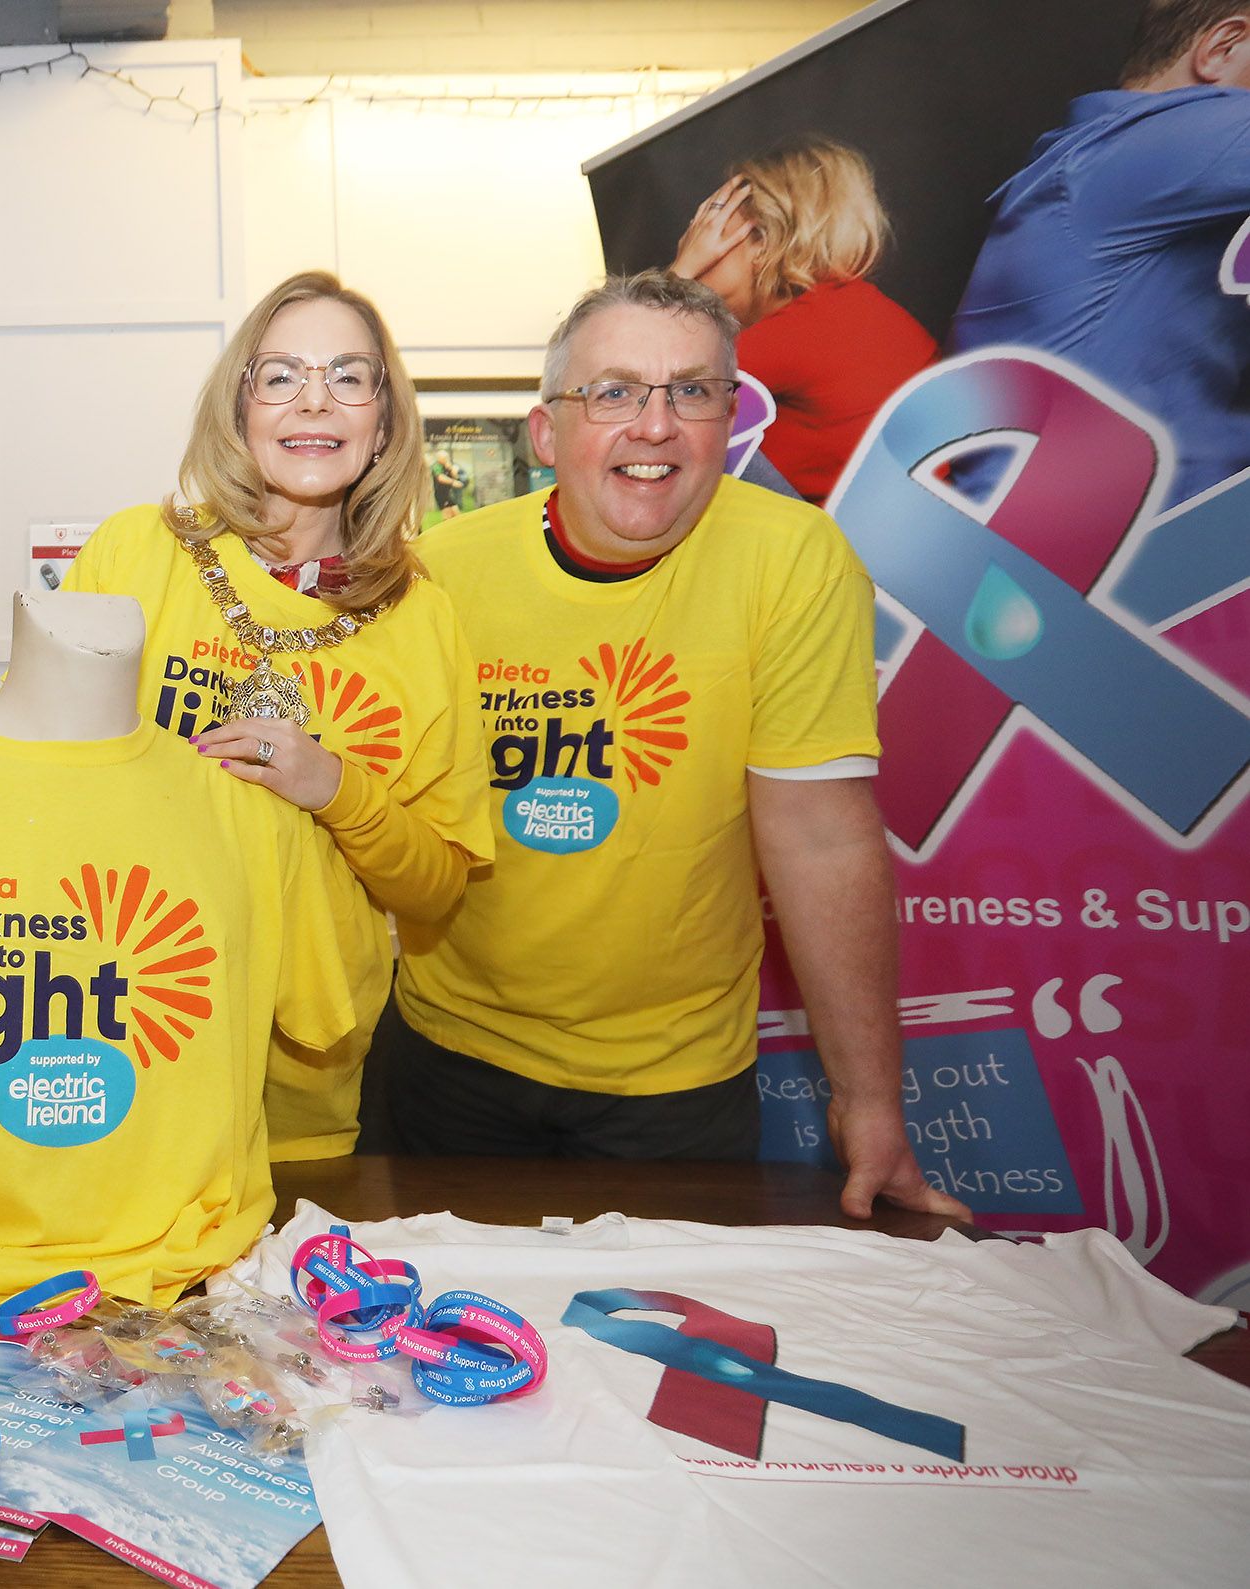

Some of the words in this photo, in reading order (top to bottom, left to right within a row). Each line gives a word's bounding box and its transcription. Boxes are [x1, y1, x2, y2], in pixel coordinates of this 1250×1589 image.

[62, 548, 79, 557] Plea
[478, 658, 550, 684] pieta
[480, 688, 597, 713] arkness
[494, 715, 539, 731] into
[490, 717, 614, 791] ght
[576, 788, 590, 799] by
[516, 799, 594, 822] electric
[523, 816, 594, 840] Ireland
[896, 894, 1063, 927] reness
[1080, 888, 1120, 930] &
[29, 1054, 84, 1068] supported
[87, 1053, 101, 1067] by
[933, 1053, 1010, 1089] out
[9, 1073, 106, 1100] electric
[26, 1097, 106, 1127] Ireland
[794, 1121, 821, 1148] is
[905, 1101, 992, 1153] ngth
[926, 1158, 1064, 1195] akness
[18, 1318, 44, 1330] Reach
[45, 1313, 63, 1326] Out
[442, 1306, 469, 1319] Support
[470, 1311, 476, 1321] &
[477, 1313, 520, 1342] Awareness
[336, 1346, 375, 1360] Awareness
[376, 1348, 383, 1358] &
[402, 1337, 445, 1360] Awareness
[445, 1351, 452, 1362] &
[453, 1353, 480, 1370] Support
[520, 1338, 541, 1364] Suicide
[479, 1378, 507, 1389] Group
[508, 1366, 532, 1382] Support
[14, 1389, 85, 1415] Suicide
[426, 1385, 453, 1403] Group
[454, 1393, 485, 1404] Support
[189, 1443, 312, 1495] Awareness
[156, 1465, 227, 1502] Group
[172, 1455, 219, 1477] and
[217, 1471, 313, 1516] Support
[104, 1537, 177, 1579] Information
